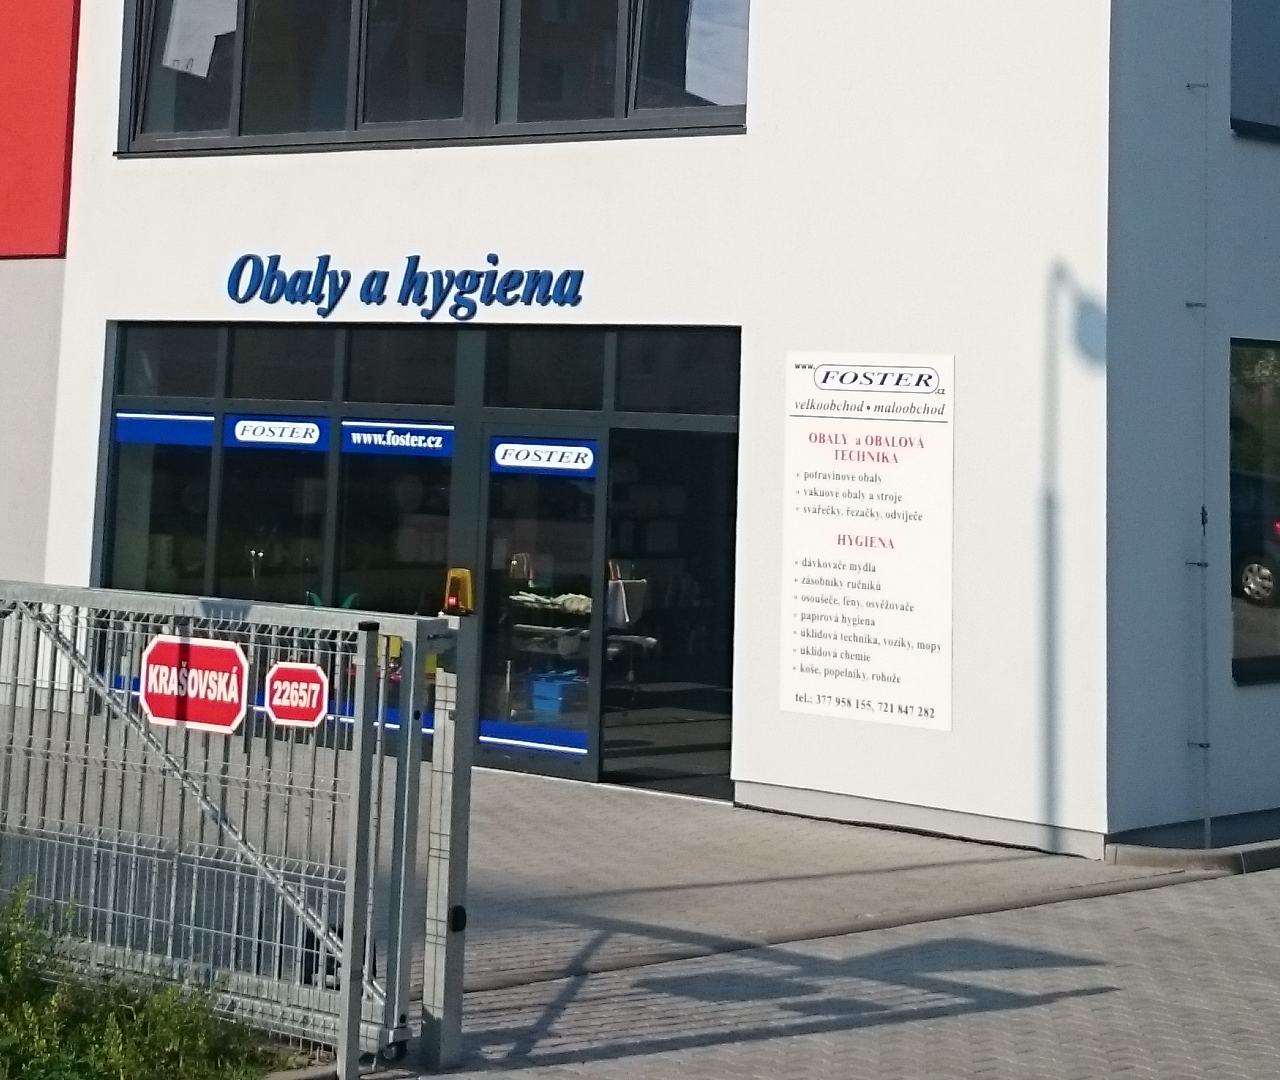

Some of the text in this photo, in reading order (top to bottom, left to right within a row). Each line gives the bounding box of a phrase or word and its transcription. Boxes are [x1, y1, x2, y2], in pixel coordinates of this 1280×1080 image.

[227, 252, 585, 321] Obaly a hygiena
[820, 370, 933, 387] FOSTER
[794, 398, 946, 415] velkoobchod maloobchod
[239, 423, 316, 440] FOSTER
[350, 429, 444, 449] www.foster.cz
[808, 432, 925, 448] OBALY a OBALOVÁ
[500, 447, 590, 465] FOSTER
[833, 449, 899, 463] TECHNIKA
[858, 472, 883, 484] obaly
[841, 489, 866, 501] obaly
[869, 492, 874, 500] a
[876, 492, 903, 504] stroje
[837, 533, 895, 549] HYGIENA
[801, 557, 847, 571] dávkovače
[865, 599, 915, 612] osvěžovače
[841, 613, 876, 627] hygiena
[840, 632, 881, 646] technika,
[917, 641, 941, 654] mopy
[840, 650, 871, 662] chemie
[148, 660, 239, 704] KRAŠOVSKÁ
[871, 671, 901, 683] rohože
[272, 680, 321, 708] 2265/7
[815, 694, 832, 705] 377
[835, 697, 852, 708] 958
[855, 698, 874, 712] 155,
[877, 702, 894, 713] 721
[897, 705, 914, 716] 847
[917, 706, 935, 718] 282
